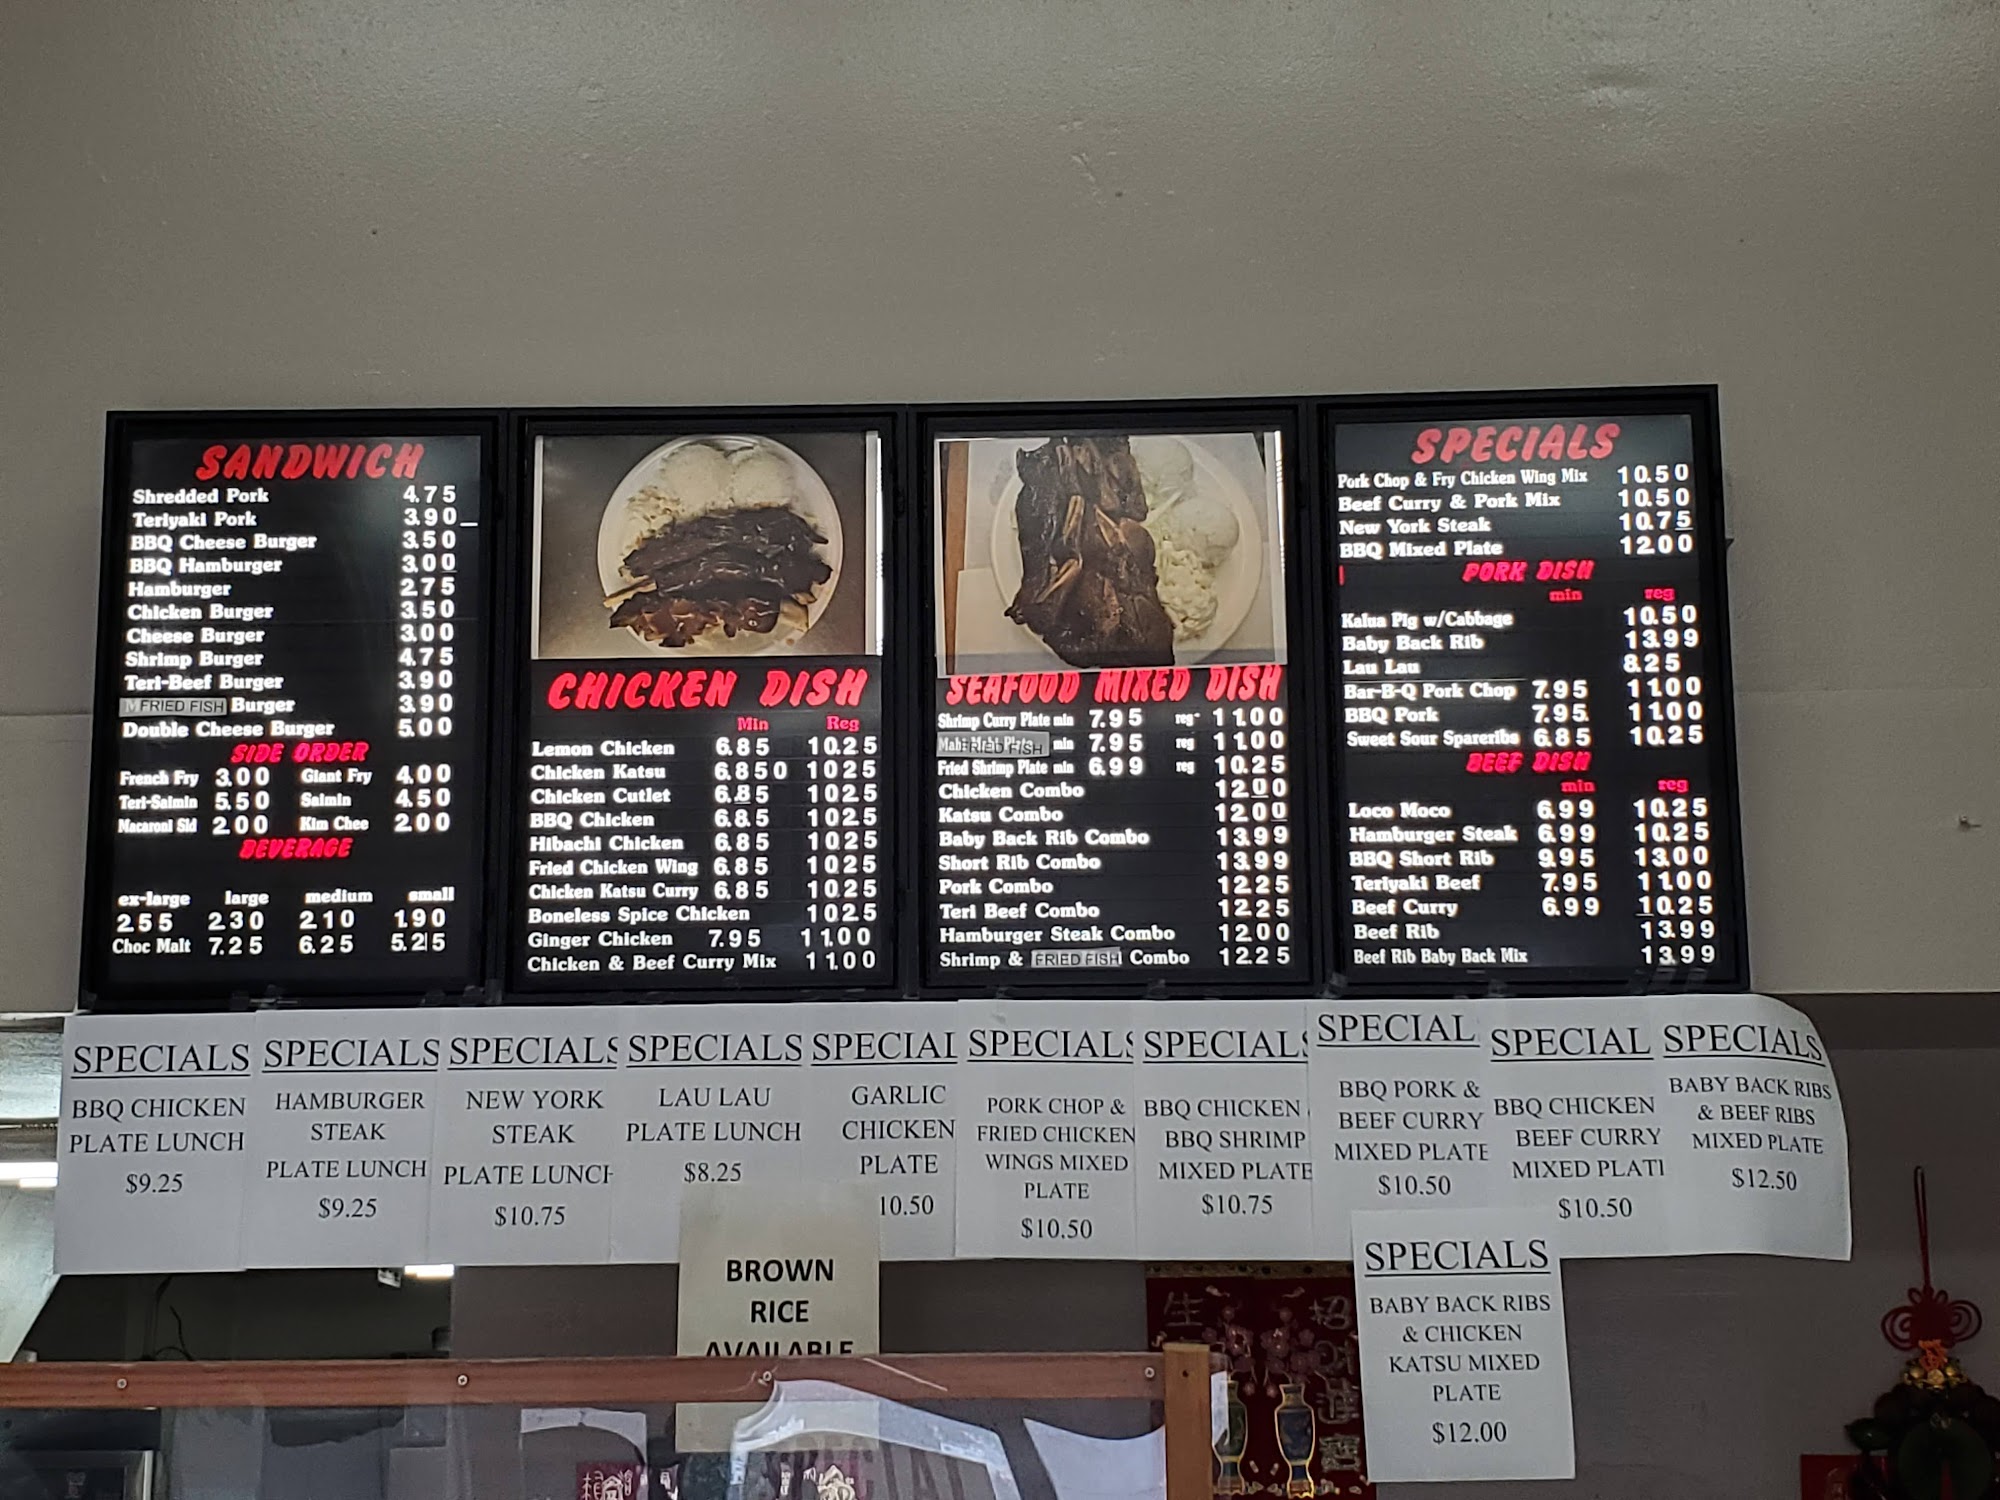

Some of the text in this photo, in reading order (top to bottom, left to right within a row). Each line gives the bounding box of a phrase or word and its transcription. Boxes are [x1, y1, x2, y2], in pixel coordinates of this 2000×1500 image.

[1412, 425, 1619, 463] SPECIALS
[196, 445, 421, 480] SANDWICH
[133, 489, 218, 504] Shredded
[227, 488, 269, 502] Pork
[1339, 496, 1381, 511] Beef
[1388, 496, 1441, 512] Curry
[1450, 494, 1467, 509] &
[1474, 492, 1518, 508] Pork
[1525, 492, 1561, 507] Mix
[131, 535, 173, 552] BBQ
[179, 535, 246, 550] Cheese
[254, 534, 317, 551] Burger
[1463, 560, 1594, 582] PORK DISH
[129, 580, 231, 599] Hamburger
[1343, 635, 1389, 654] Baby
[1396, 635, 1443, 650] Back
[1450, 634, 1484, 649] Rib
[547, 668, 868, 710] CHICKEN DISH
[946, 664, 1283, 705] SEAFOOD MIXED DISH
[141, 700, 223, 712] FRIED FISH
[231, 697, 295, 715] Burger
[738, 715, 860, 732] Min Reg
[938, 713, 980, 731] Shrimp
[983, 712, 1017, 730] Curry
[1020, 712, 1050, 727] Plate
[1053, 713, 1074, 726] min
[1175, 713, 1195, 726] reg
[231, 742, 369, 764] SIDE ORDER
[532, 742, 593, 756] Lemon
[600, 740, 674, 756] Chicken
[1466, 751, 1591, 773] BEEF DISH
[120, 770, 169, 785] French
[174, 770, 199, 787] Fry
[301, 768, 342, 783] Giant
[347, 768, 372, 785] Fry
[1349, 803, 1393, 818] Loco
[1400, 802, 1451, 818] Moco
[239, 837, 352, 859] BEVERAGE
[939, 830, 985, 849] Baby
[993, 830, 1038, 846] Back
[1045, 829, 1078, 845] Rib
[1085, 828, 1150, 845] Combo
[119, 887, 454, 908] ex-large large medium small
[113, 939, 150, 953] Choc
[157, 938, 190, 953] Malt
[528, 932, 590, 949] Ginger
[599, 931, 672, 946] Chicken
[528, 956, 599, 972] Chicken
[609, 956, 624, 970] &
[633, 955, 675, 970] Beef
[683, 954, 734, 971] Curry
[743, 954, 776, 968] Mix
[940, 951, 1023, 969] Shrimp &
[1036, 954, 1080, 965] FRIED
[1130, 949, 1189, 964] Combo
[1354, 949, 1385, 964] Beef
[1391, 949, 1416, 963] Rib
[1421, 948, 1455, 966] Baby
[1461, 948, 1496, 963] Back
[1501, 948, 1527, 962] Mix
[629, 1034, 801, 1062] SPECIALS
[1665, 1020, 1825, 1060] SPECIALS
[74, 1044, 248, 1073] SPECIALS
[265, 1039, 439, 1067] SPECIALS
[660, 1088, 769, 1106] LAU LAU
[852, 1086, 945, 1105] GARLIC
[1340, 1081, 1480, 1101] BBQ PORK &
[1670, 1077, 1831, 1099] BABY BACK RIBS
[73, 1098, 244, 1122] BBQ CHICKEN
[277, 1093, 424, 1109] HAMBURGER
[1340, 1112, 1482, 1129] BEEF CURRY
[1698, 1105, 1814, 1125] & BEEF RIBS
[312, 1124, 384, 1140] STEAK
[628, 1123, 800, 1141] PLATE LUNCH
[843, 1120, 954, 1139] CHICKEN
[71, 1132, 243, 1152] PLATE LUNCH
[1693, 1133, 1823, 1153] MIXED PLATE
[1335, 1144, 1411, 1160] MIXED
[268, 1161, 426, 1177] PLATE LUNCH
[685, 1163, 740, 1183] $8.25
[861, 1155, 937, 1174] PLATE
[126, 1174, 182, 1193] $9.25
[1379, 1175, 1450, 1195] $10.50
[1733, 1168, 1796, 1190] $12.50
[319, 1198, 376, 1218] $9.25
[1366, 1240, 1547, 1271] SPECIALS
[727, 1259, 833, 1281] BROWN
[751, 1301, 808, 1323] RICE
[1371, 1295, 1550, 1313] BABY BACK RIBS
[1403, 1325, 1521, 1342] & CHICKEN
[1390, 1354, 1539, 1372] KATSU MIXED
[1434, 1385, 1500, 1401] PLATE
[1433, 1422, 1506, 1443] $12.00
